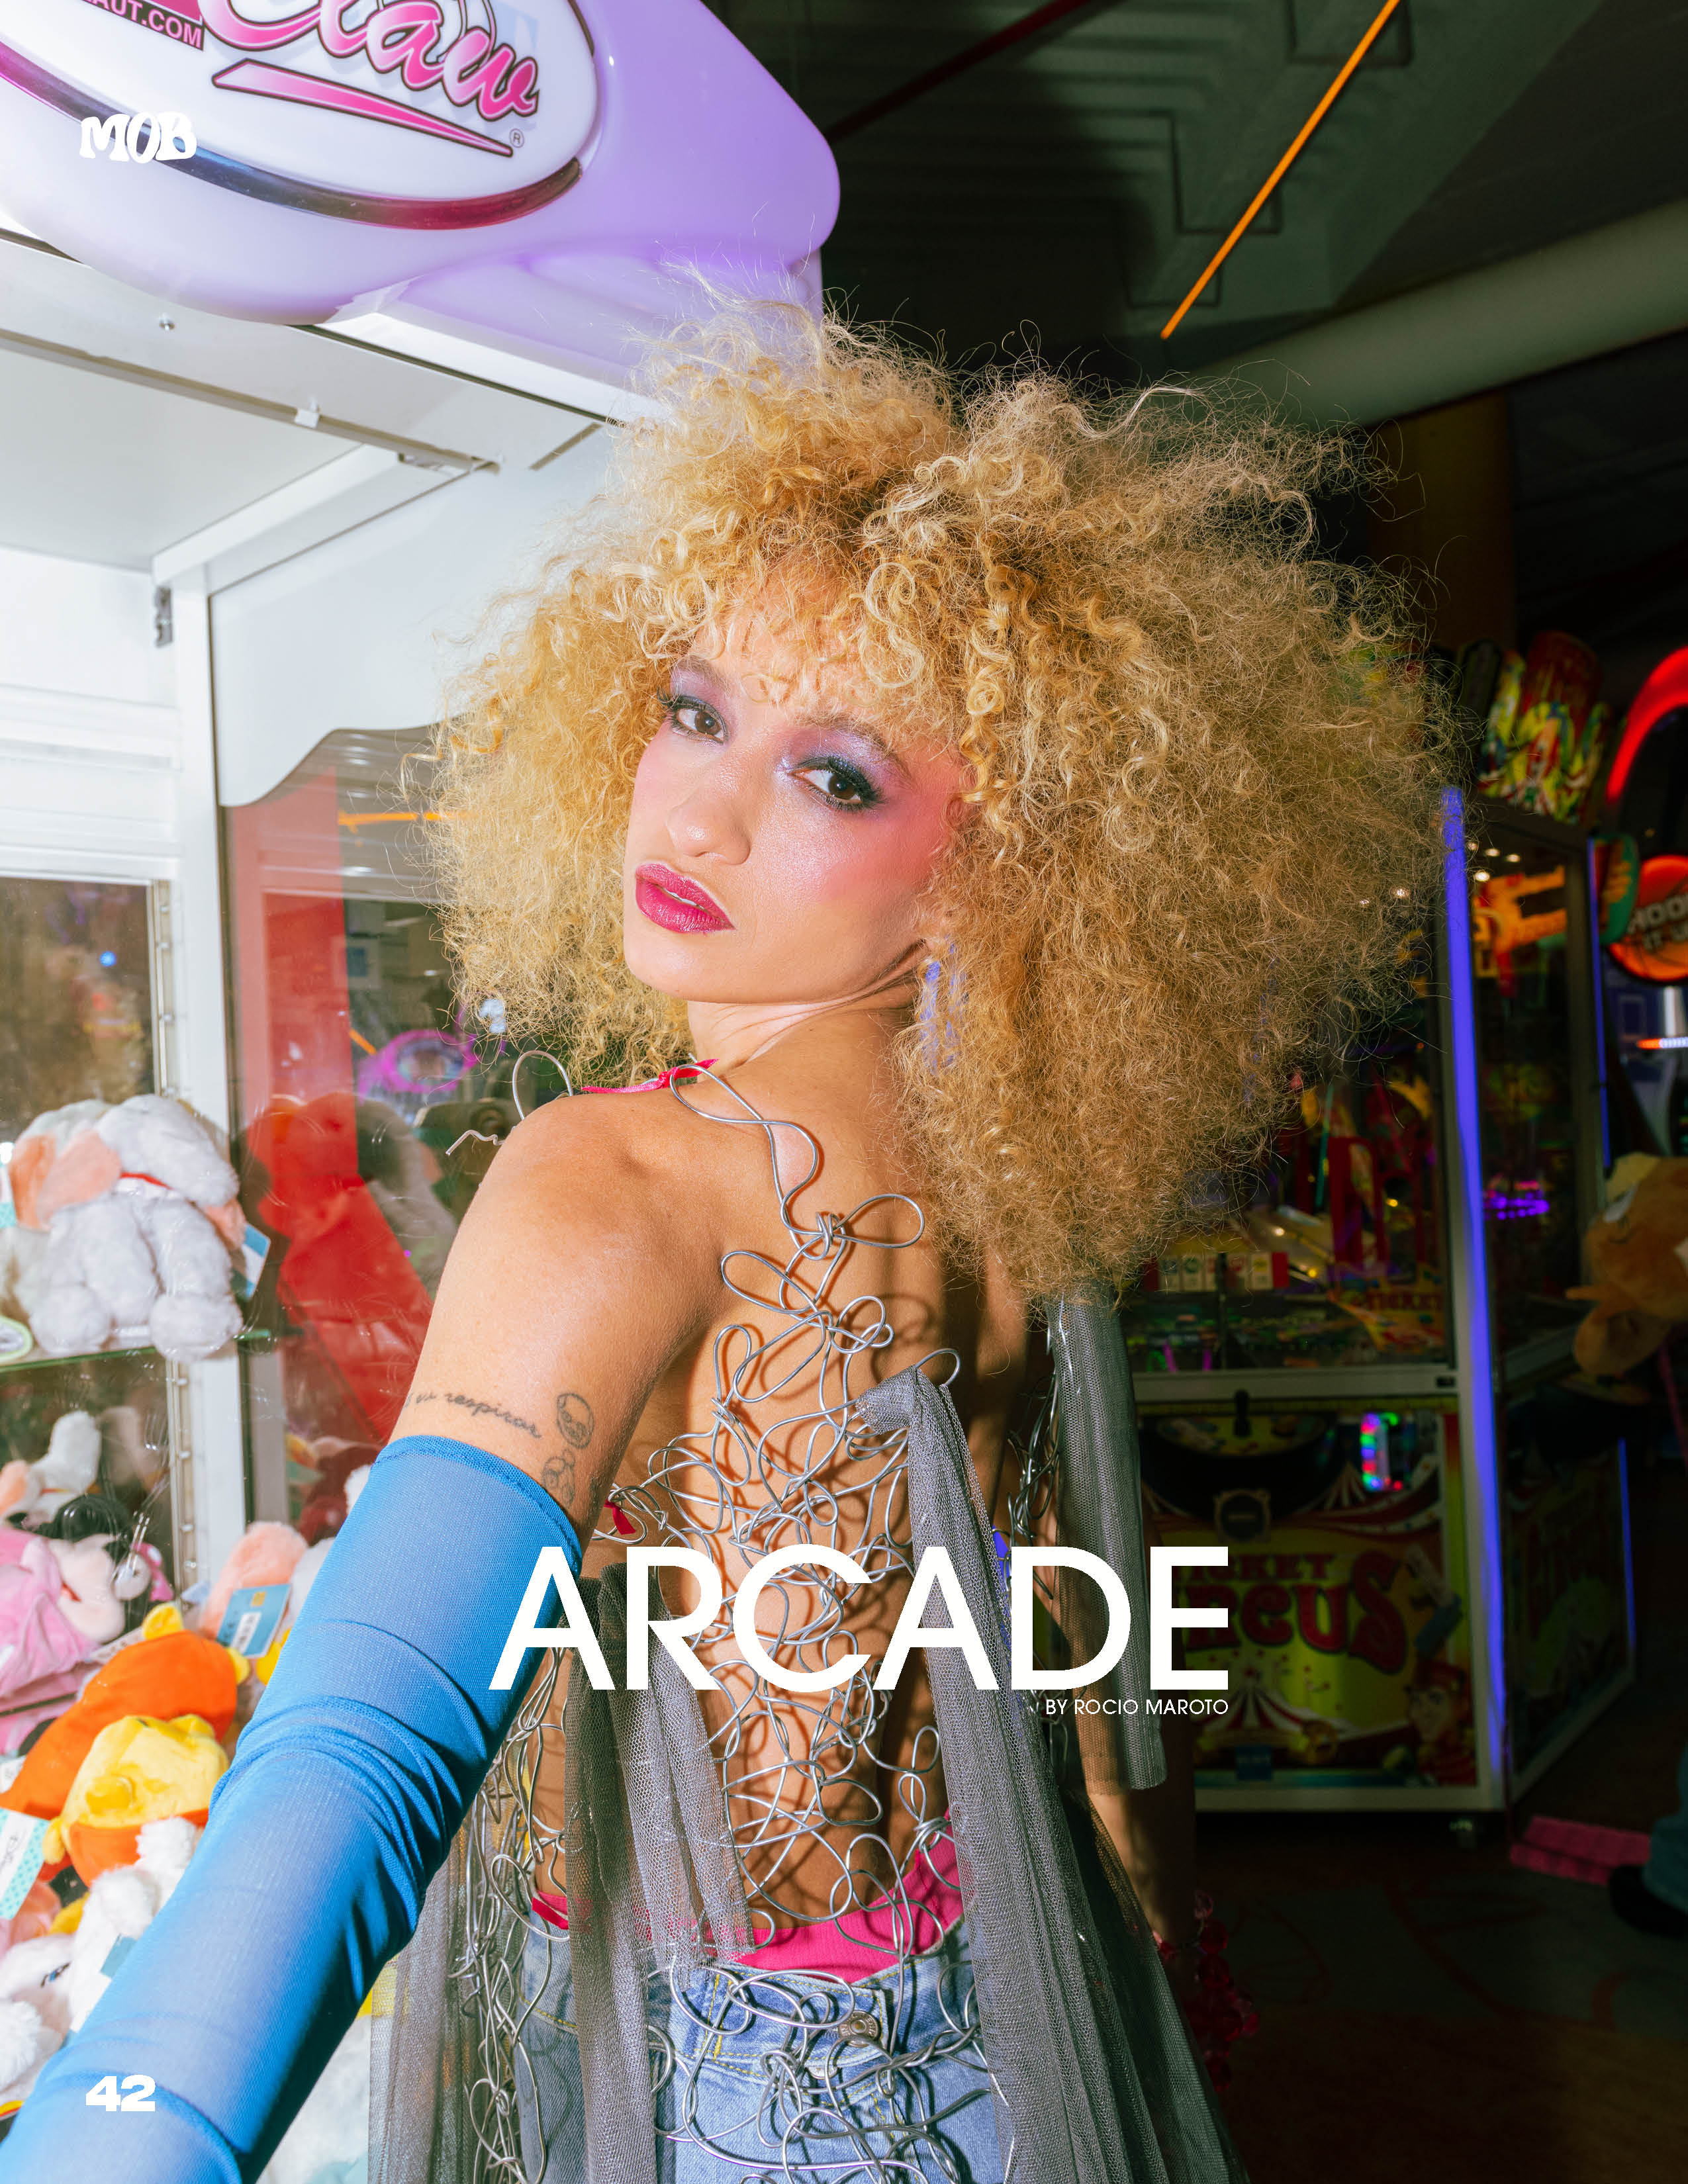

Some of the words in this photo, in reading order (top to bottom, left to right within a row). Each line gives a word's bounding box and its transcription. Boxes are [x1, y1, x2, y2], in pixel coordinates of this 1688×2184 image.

[86, 0, 203, 49] UT.COM
[1628, 895, 1688, 933] HOO
[1172, 1553, 1336, 1581] ICKET
[1184, 1551, 1407, 1675] RCUS
